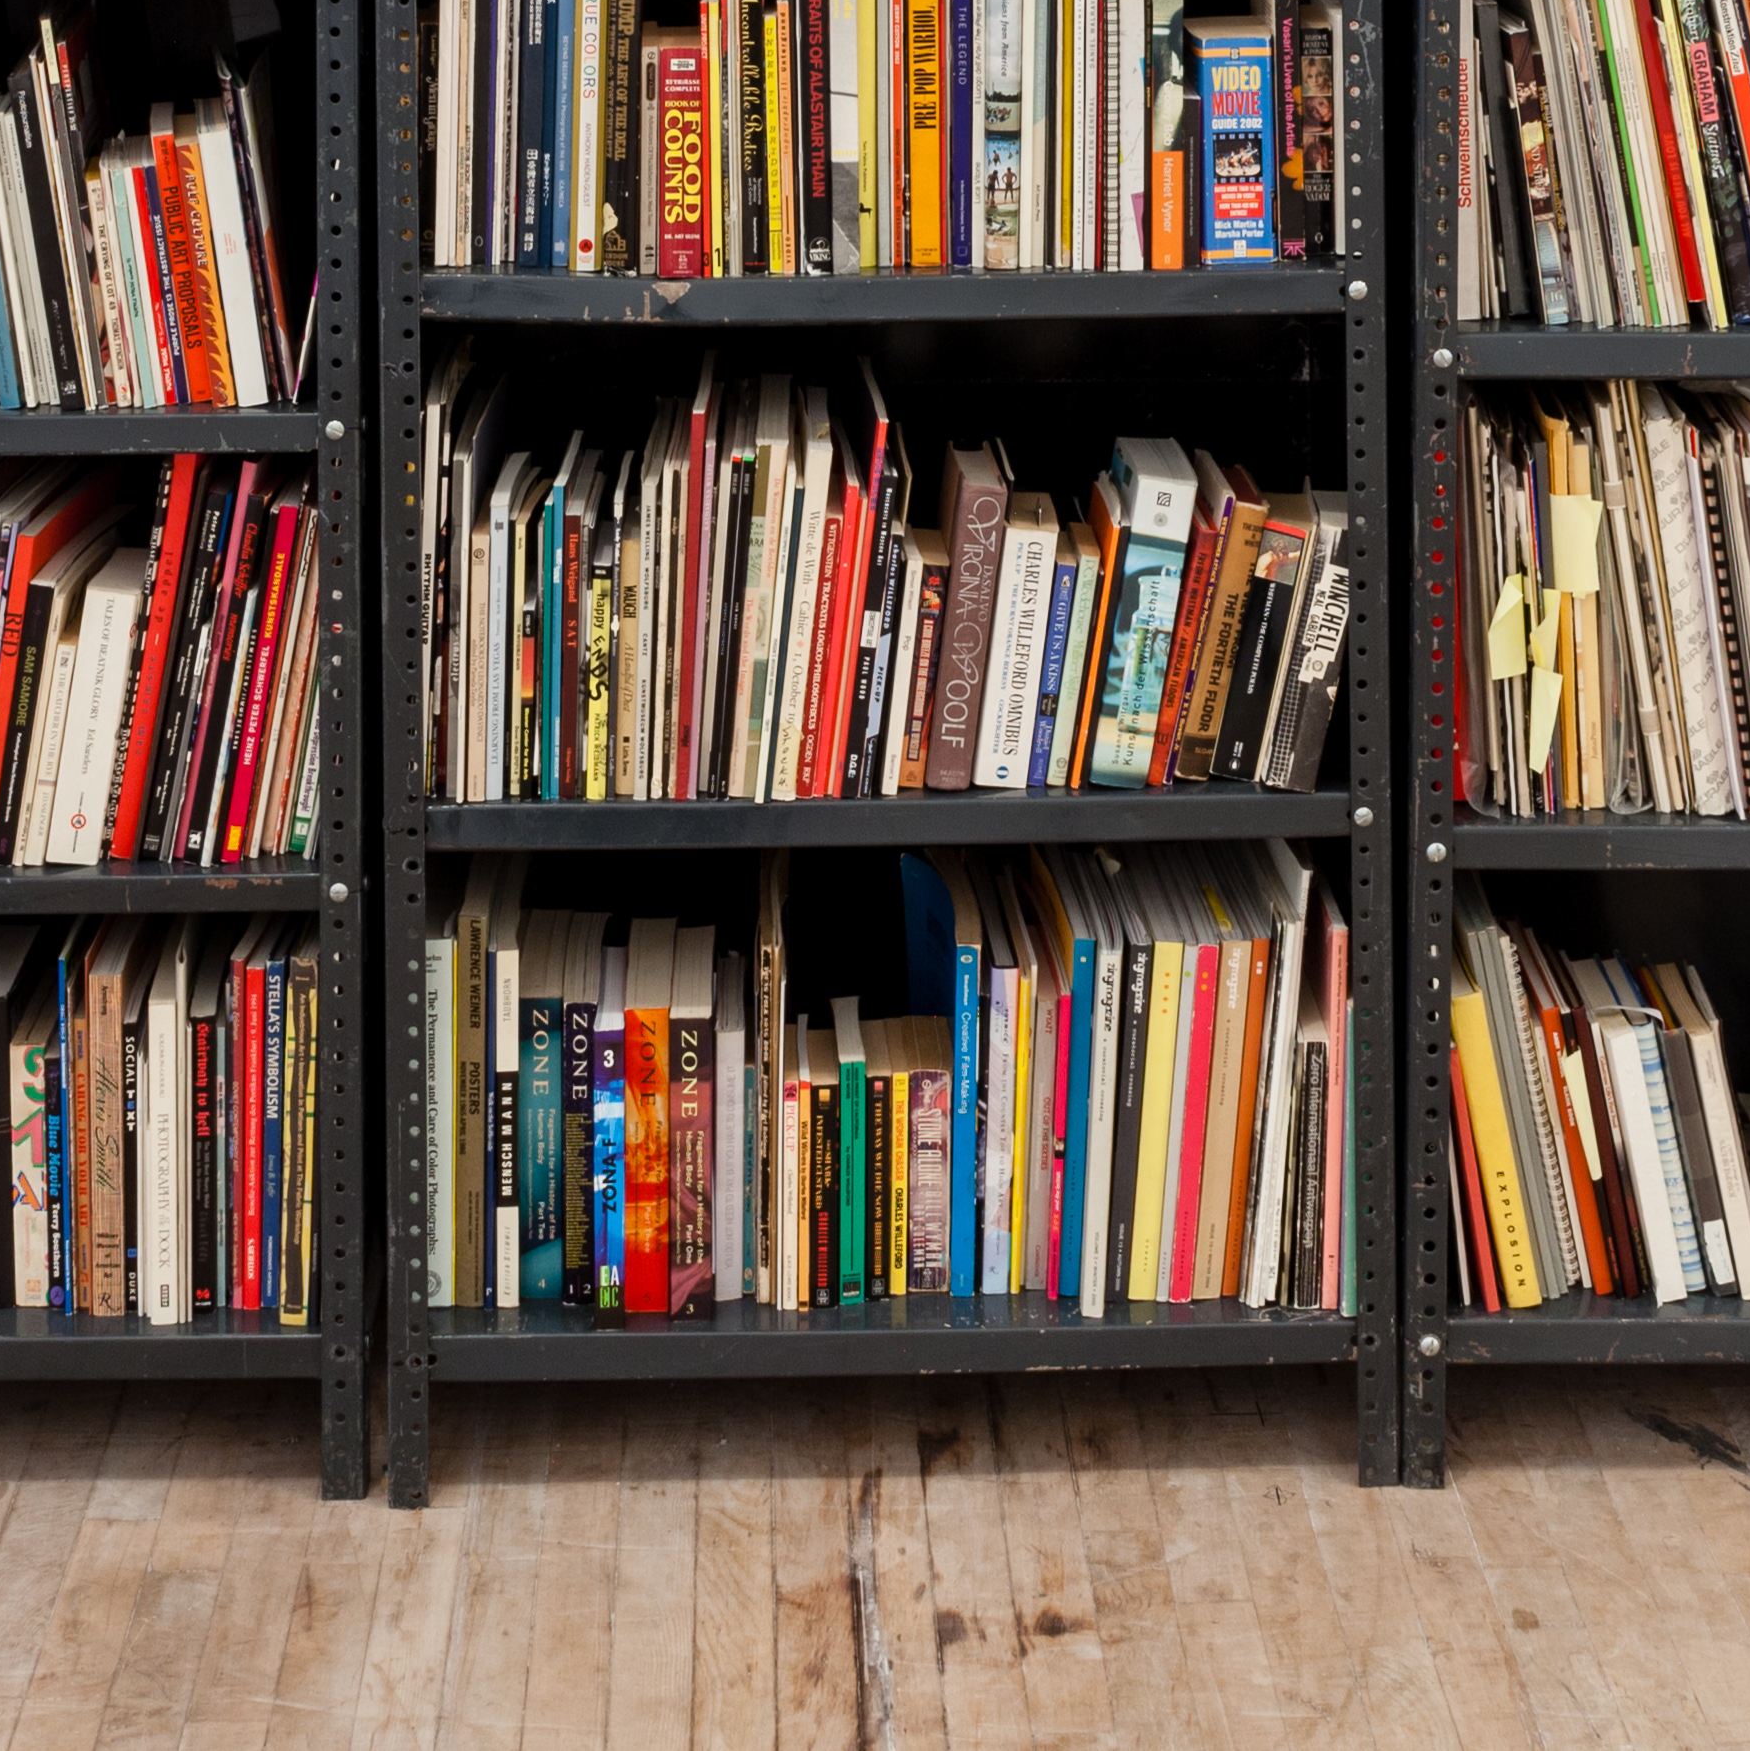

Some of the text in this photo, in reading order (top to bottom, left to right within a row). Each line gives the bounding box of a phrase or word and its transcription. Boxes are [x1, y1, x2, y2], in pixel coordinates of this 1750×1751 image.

[583, 33, 599, 99] COLORS
[810, 47, 823, 70] OF
[1211, 66, 1262, 91] VIDEO
[1693, 49, 1715, 116] GRAHAM
[743, 114, 761, 171] Bodies
[810, 71, 825, 145] ALASTAIR
[1212, 92, 1262, 116] MOVIE
[664, 110, 683, 223] COUNTS
[683, 110, 701, 222] FOOD
[812, 149, 826, 198] THAIN
[164, 186, 202, 349] PUBLIC ART PROPOSALS
[623, 585, 636, 618] WAUGH
[941, 496, 1001, 747] VIRGINIA WOOLF
[1314, 573, 1349, 652] WINCHELL
[1002, 542, 1043, 756] CHARLES WILLEFORD OMNIBUS
[266, 975, 280, 1118] STELLA'S SYMBOLISM
[531, 1009, 550, 1095] ZONE
[572, 1013, 587, 1100] ZONE
[681, 1030, 698, 1118] ZONE
[917, 1108, 942, 1187] STONE ALONE
[1497, 1171, 1526, 1288] EXPLOSION
